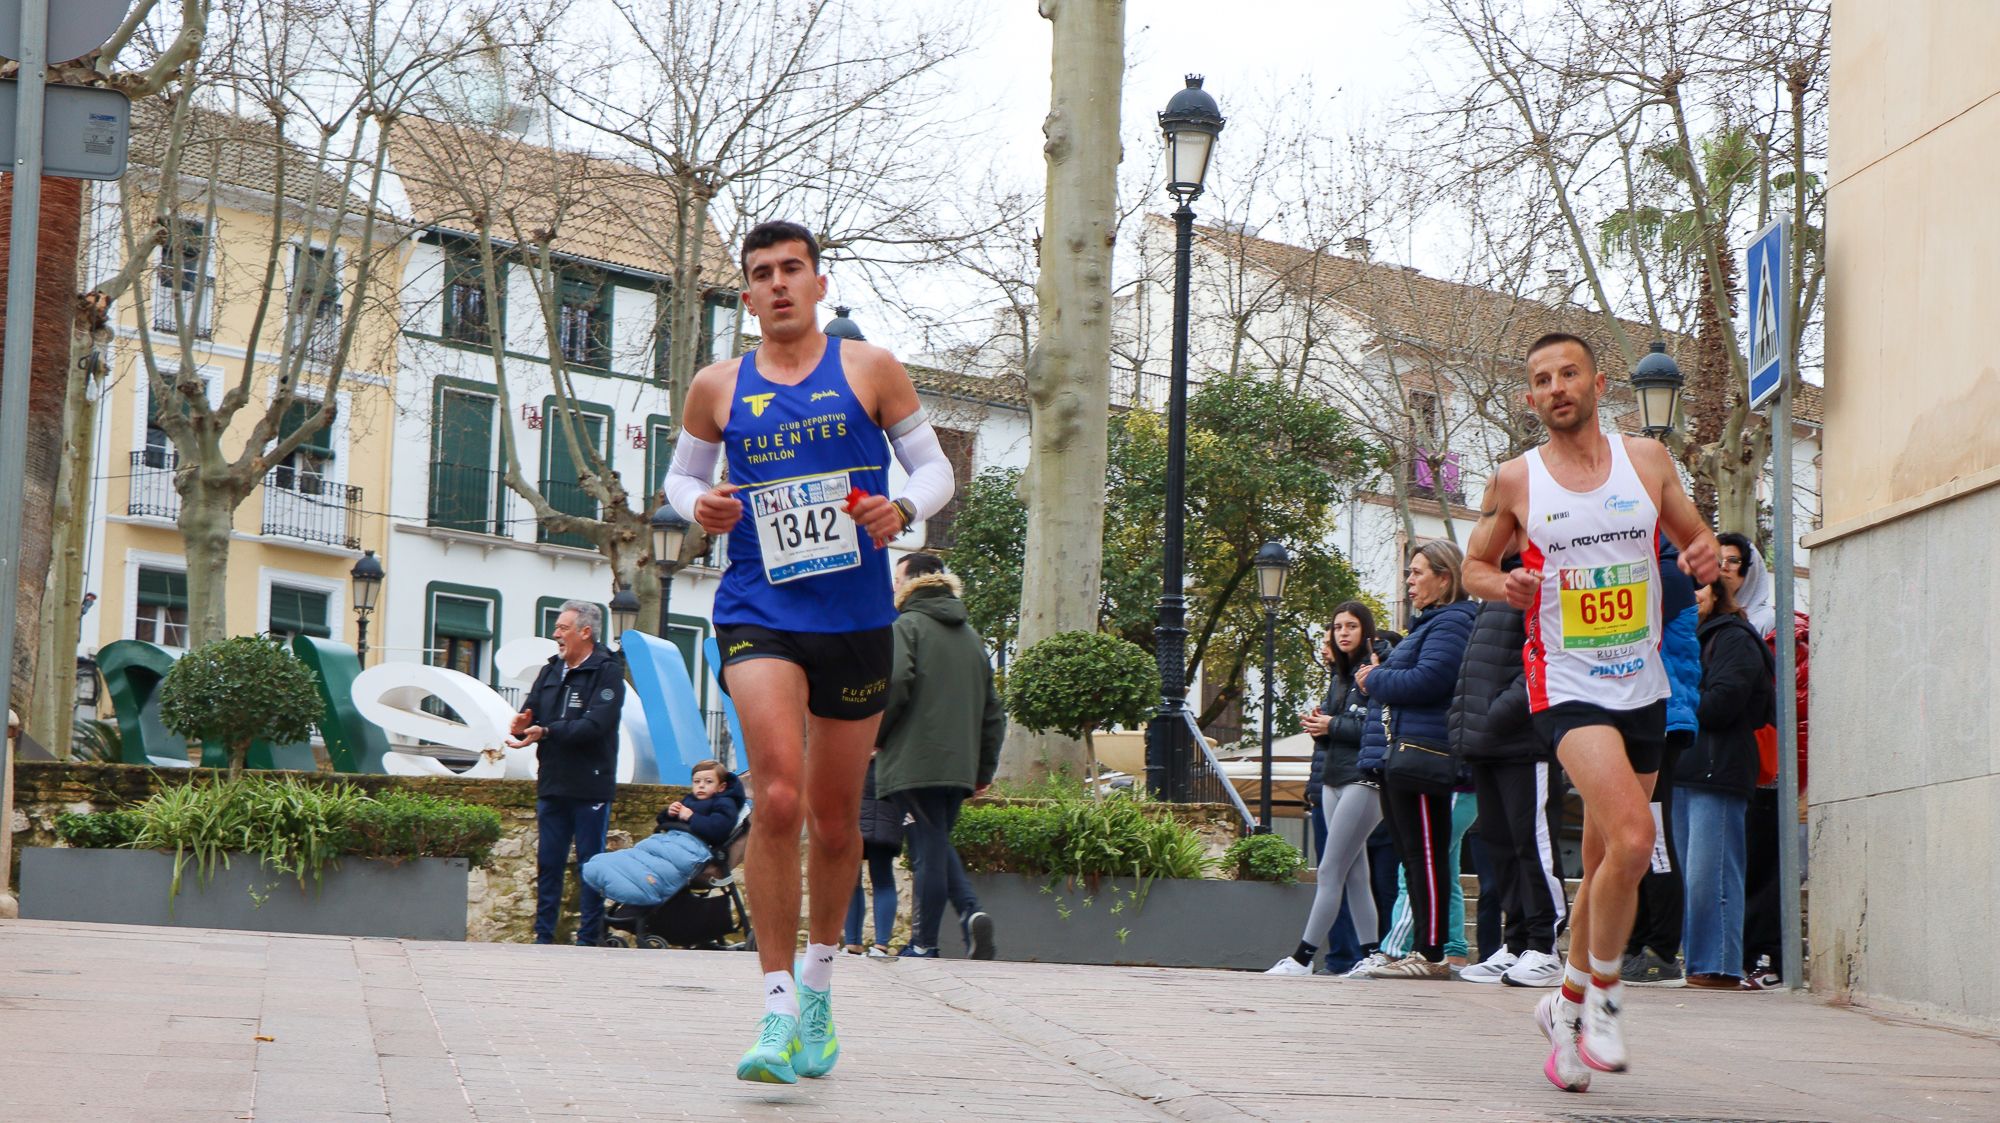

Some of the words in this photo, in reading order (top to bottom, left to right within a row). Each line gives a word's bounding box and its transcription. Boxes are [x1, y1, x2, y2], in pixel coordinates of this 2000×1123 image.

[779, 421, 801, 431] CLUB
[803, 413, 847, 427] DEPORTIVO
[743, 423, 847, 452] FUENTES
[747, 449, 795, 465] TRIATLÓN
[770, 506, 840, 551] 1342
[1549, 542, 1567, 554] AL
[1566, 568, 1597, 590] 10K
[1580, 588, 1633, 624] 659
